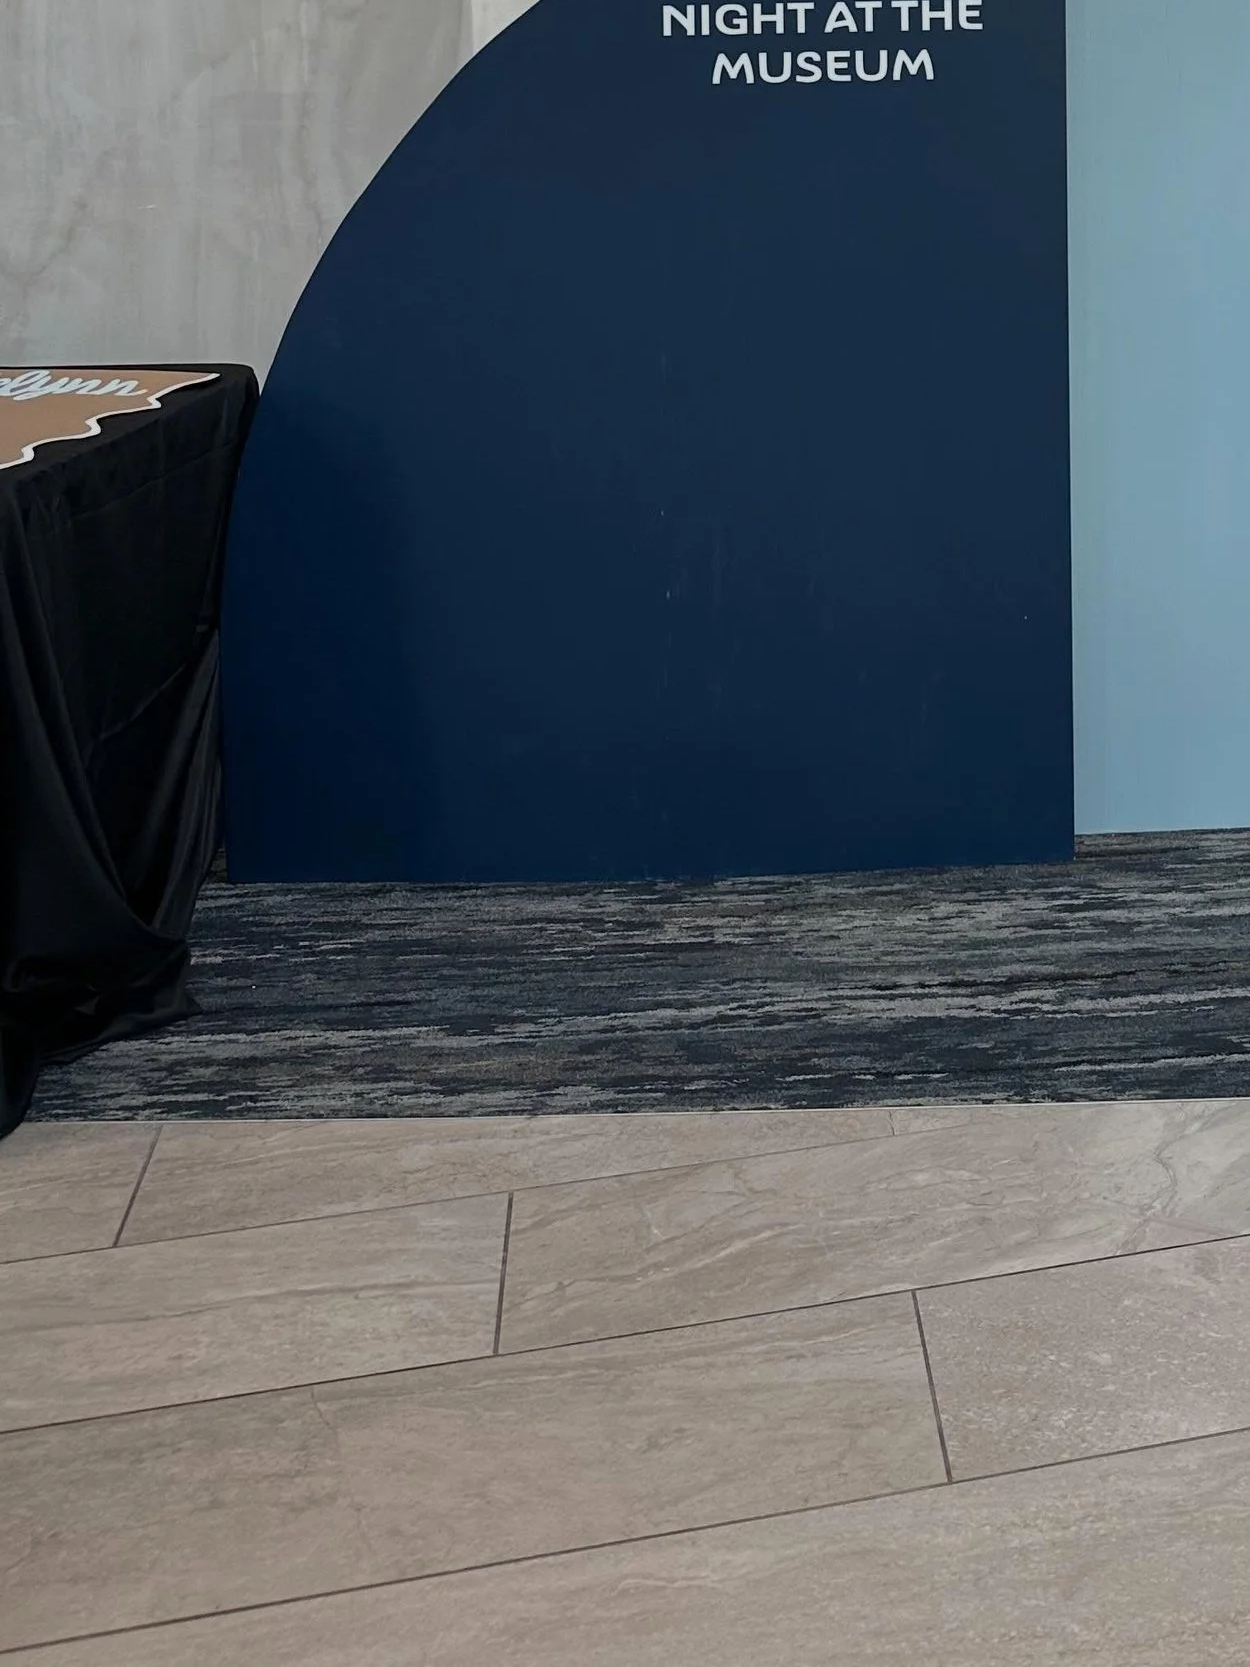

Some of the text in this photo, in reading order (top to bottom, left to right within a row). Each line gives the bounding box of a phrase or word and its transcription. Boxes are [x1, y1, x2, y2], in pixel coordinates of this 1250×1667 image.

[662, 2, 815, 36] NIGHT
[824, 0, 883, 33] AT
[712, 48, 935, 84] MUSEUM
